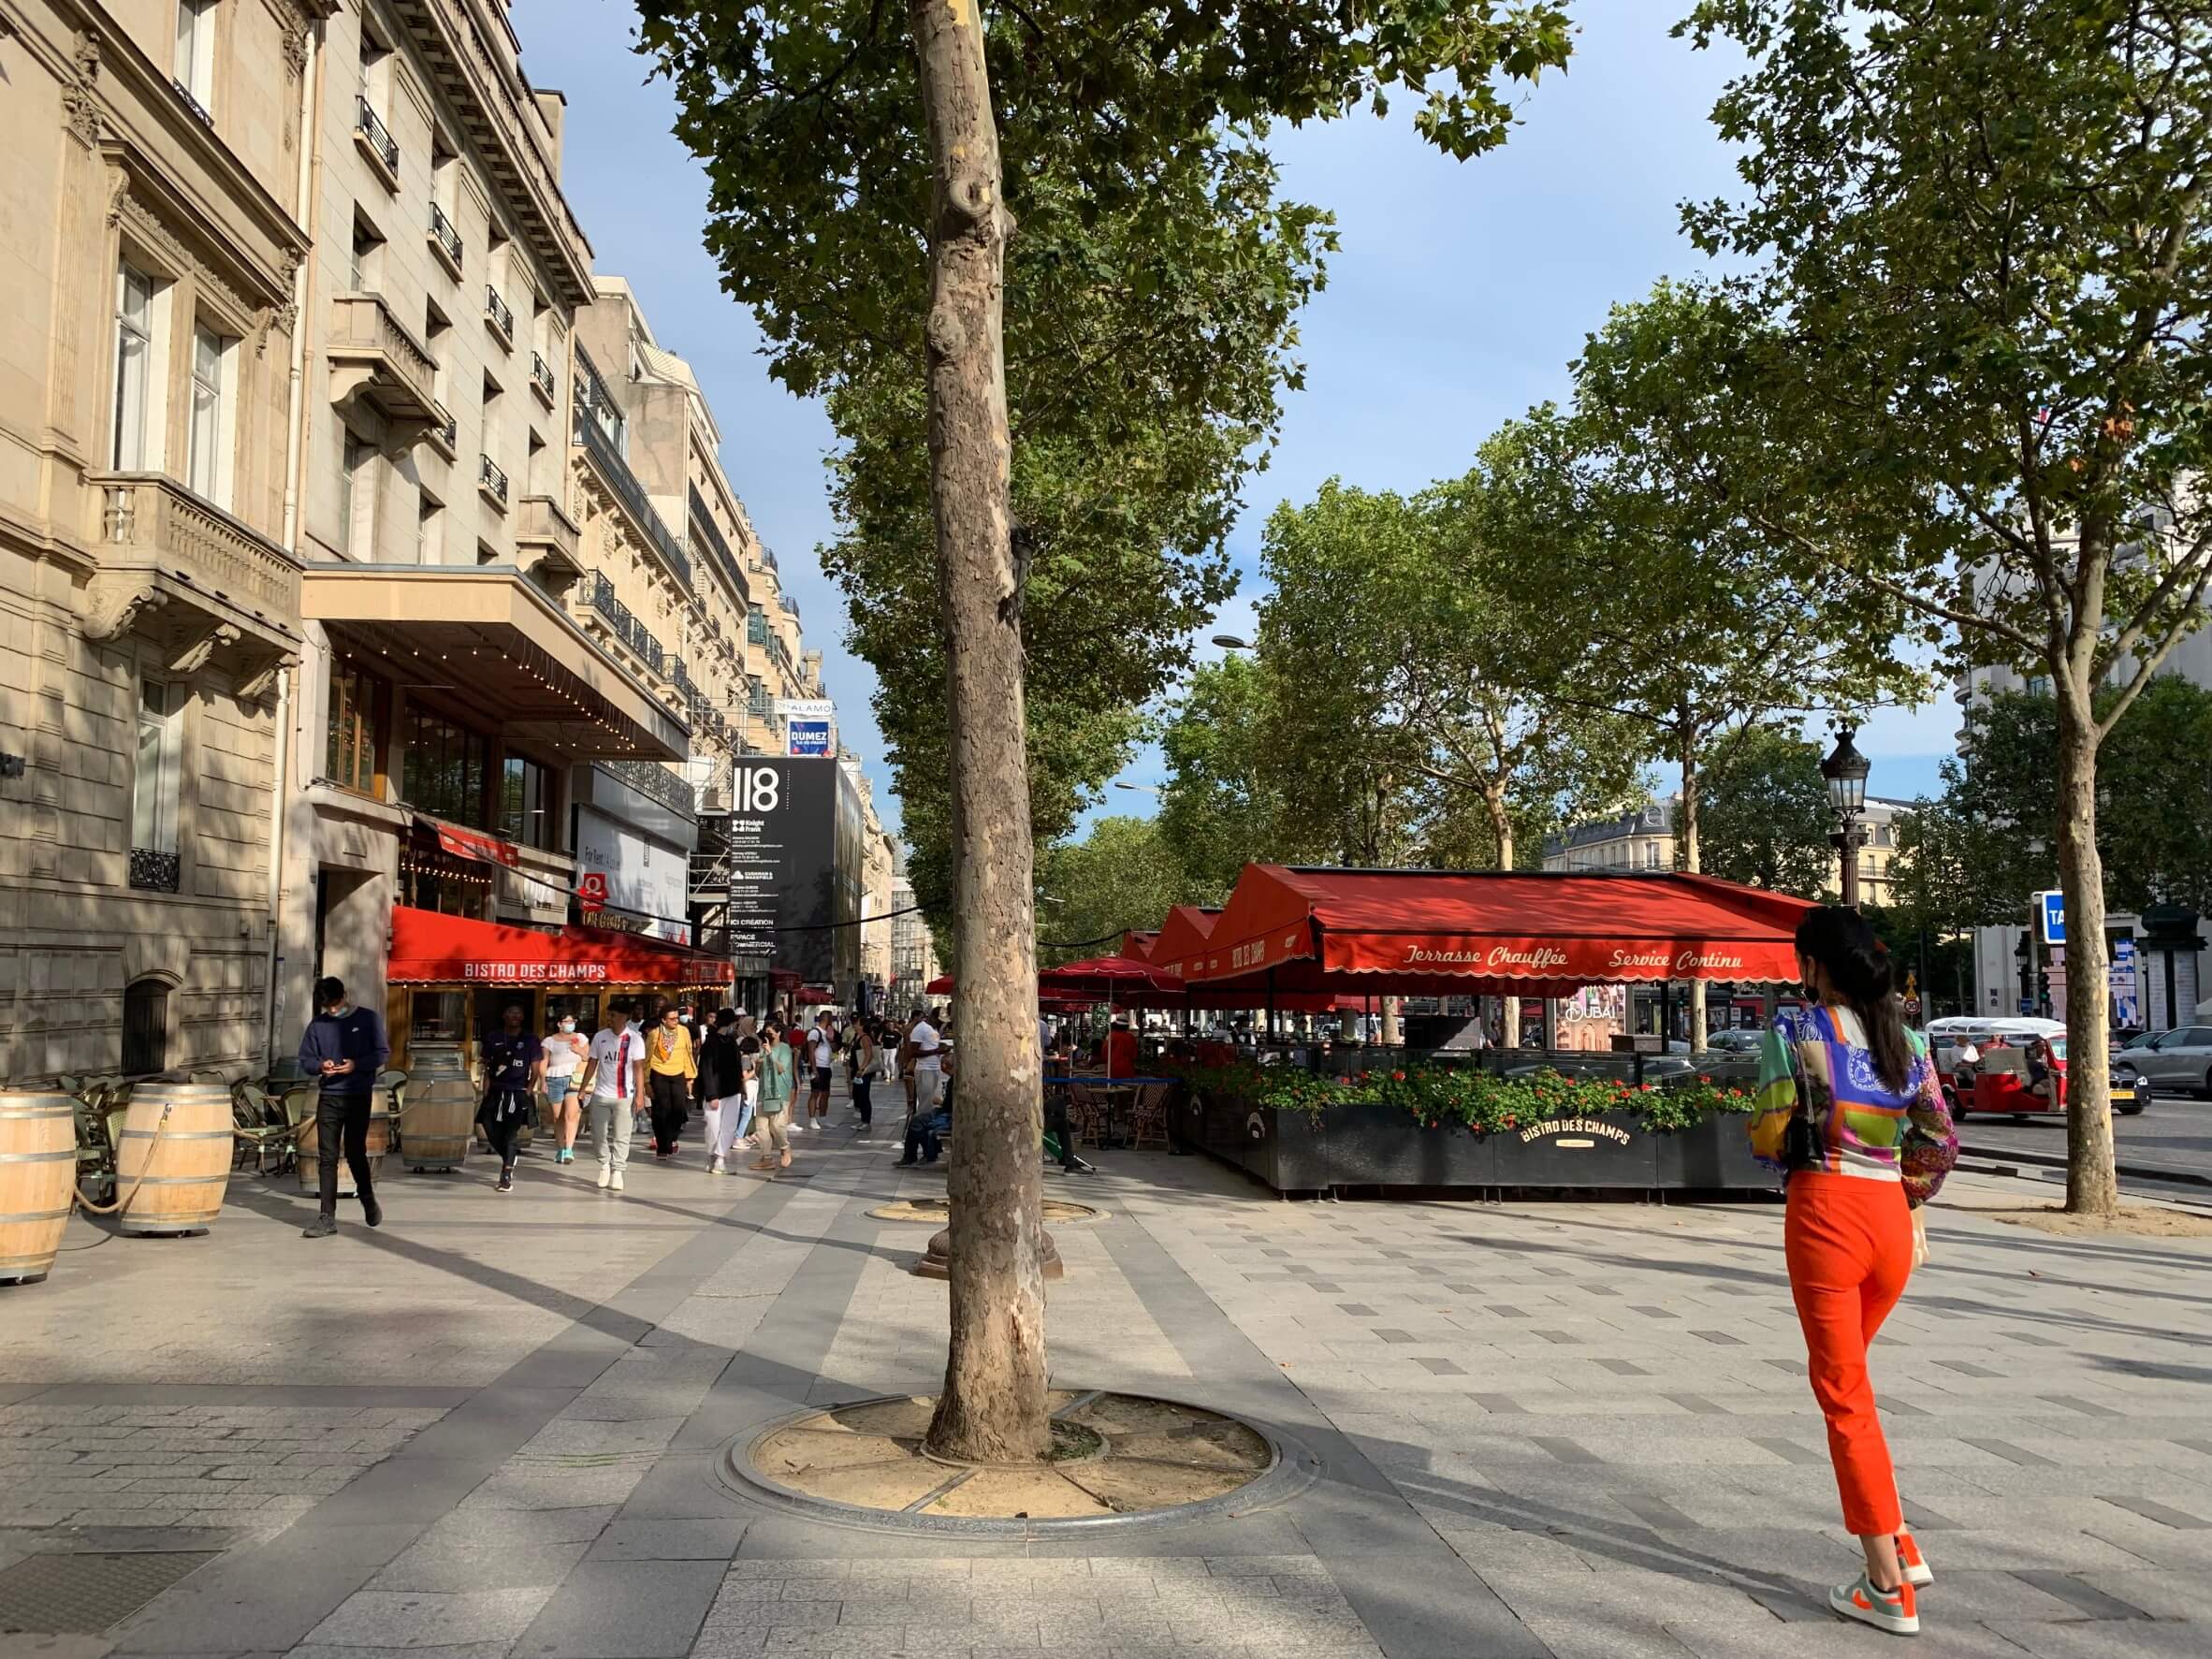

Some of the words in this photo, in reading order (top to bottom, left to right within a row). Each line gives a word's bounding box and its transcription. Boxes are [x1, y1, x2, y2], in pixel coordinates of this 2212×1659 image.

[792, 732, 827, 741] DUMEZ
[733, 767, 779, 812] 118
[2048, 910, 2066, 924] TA
[1404, 945, 1482, 963] Terrasse
[1488, 946, 1569, 968] Chauffée
[1609, 949, 1671, 968] Service
[1676, 951, 1743, 970] Continu
[464, 964, 516, 977] BISTRO
[520, 965, 546, 978] DES
[549, 965, 606, 979] CHAMPS
[1520, 1120, 1560, 1142] BISTRO
[1562, 1119, 1583, 1132] DES
[1585, 1120, 1630, 1145] CHAMPS
